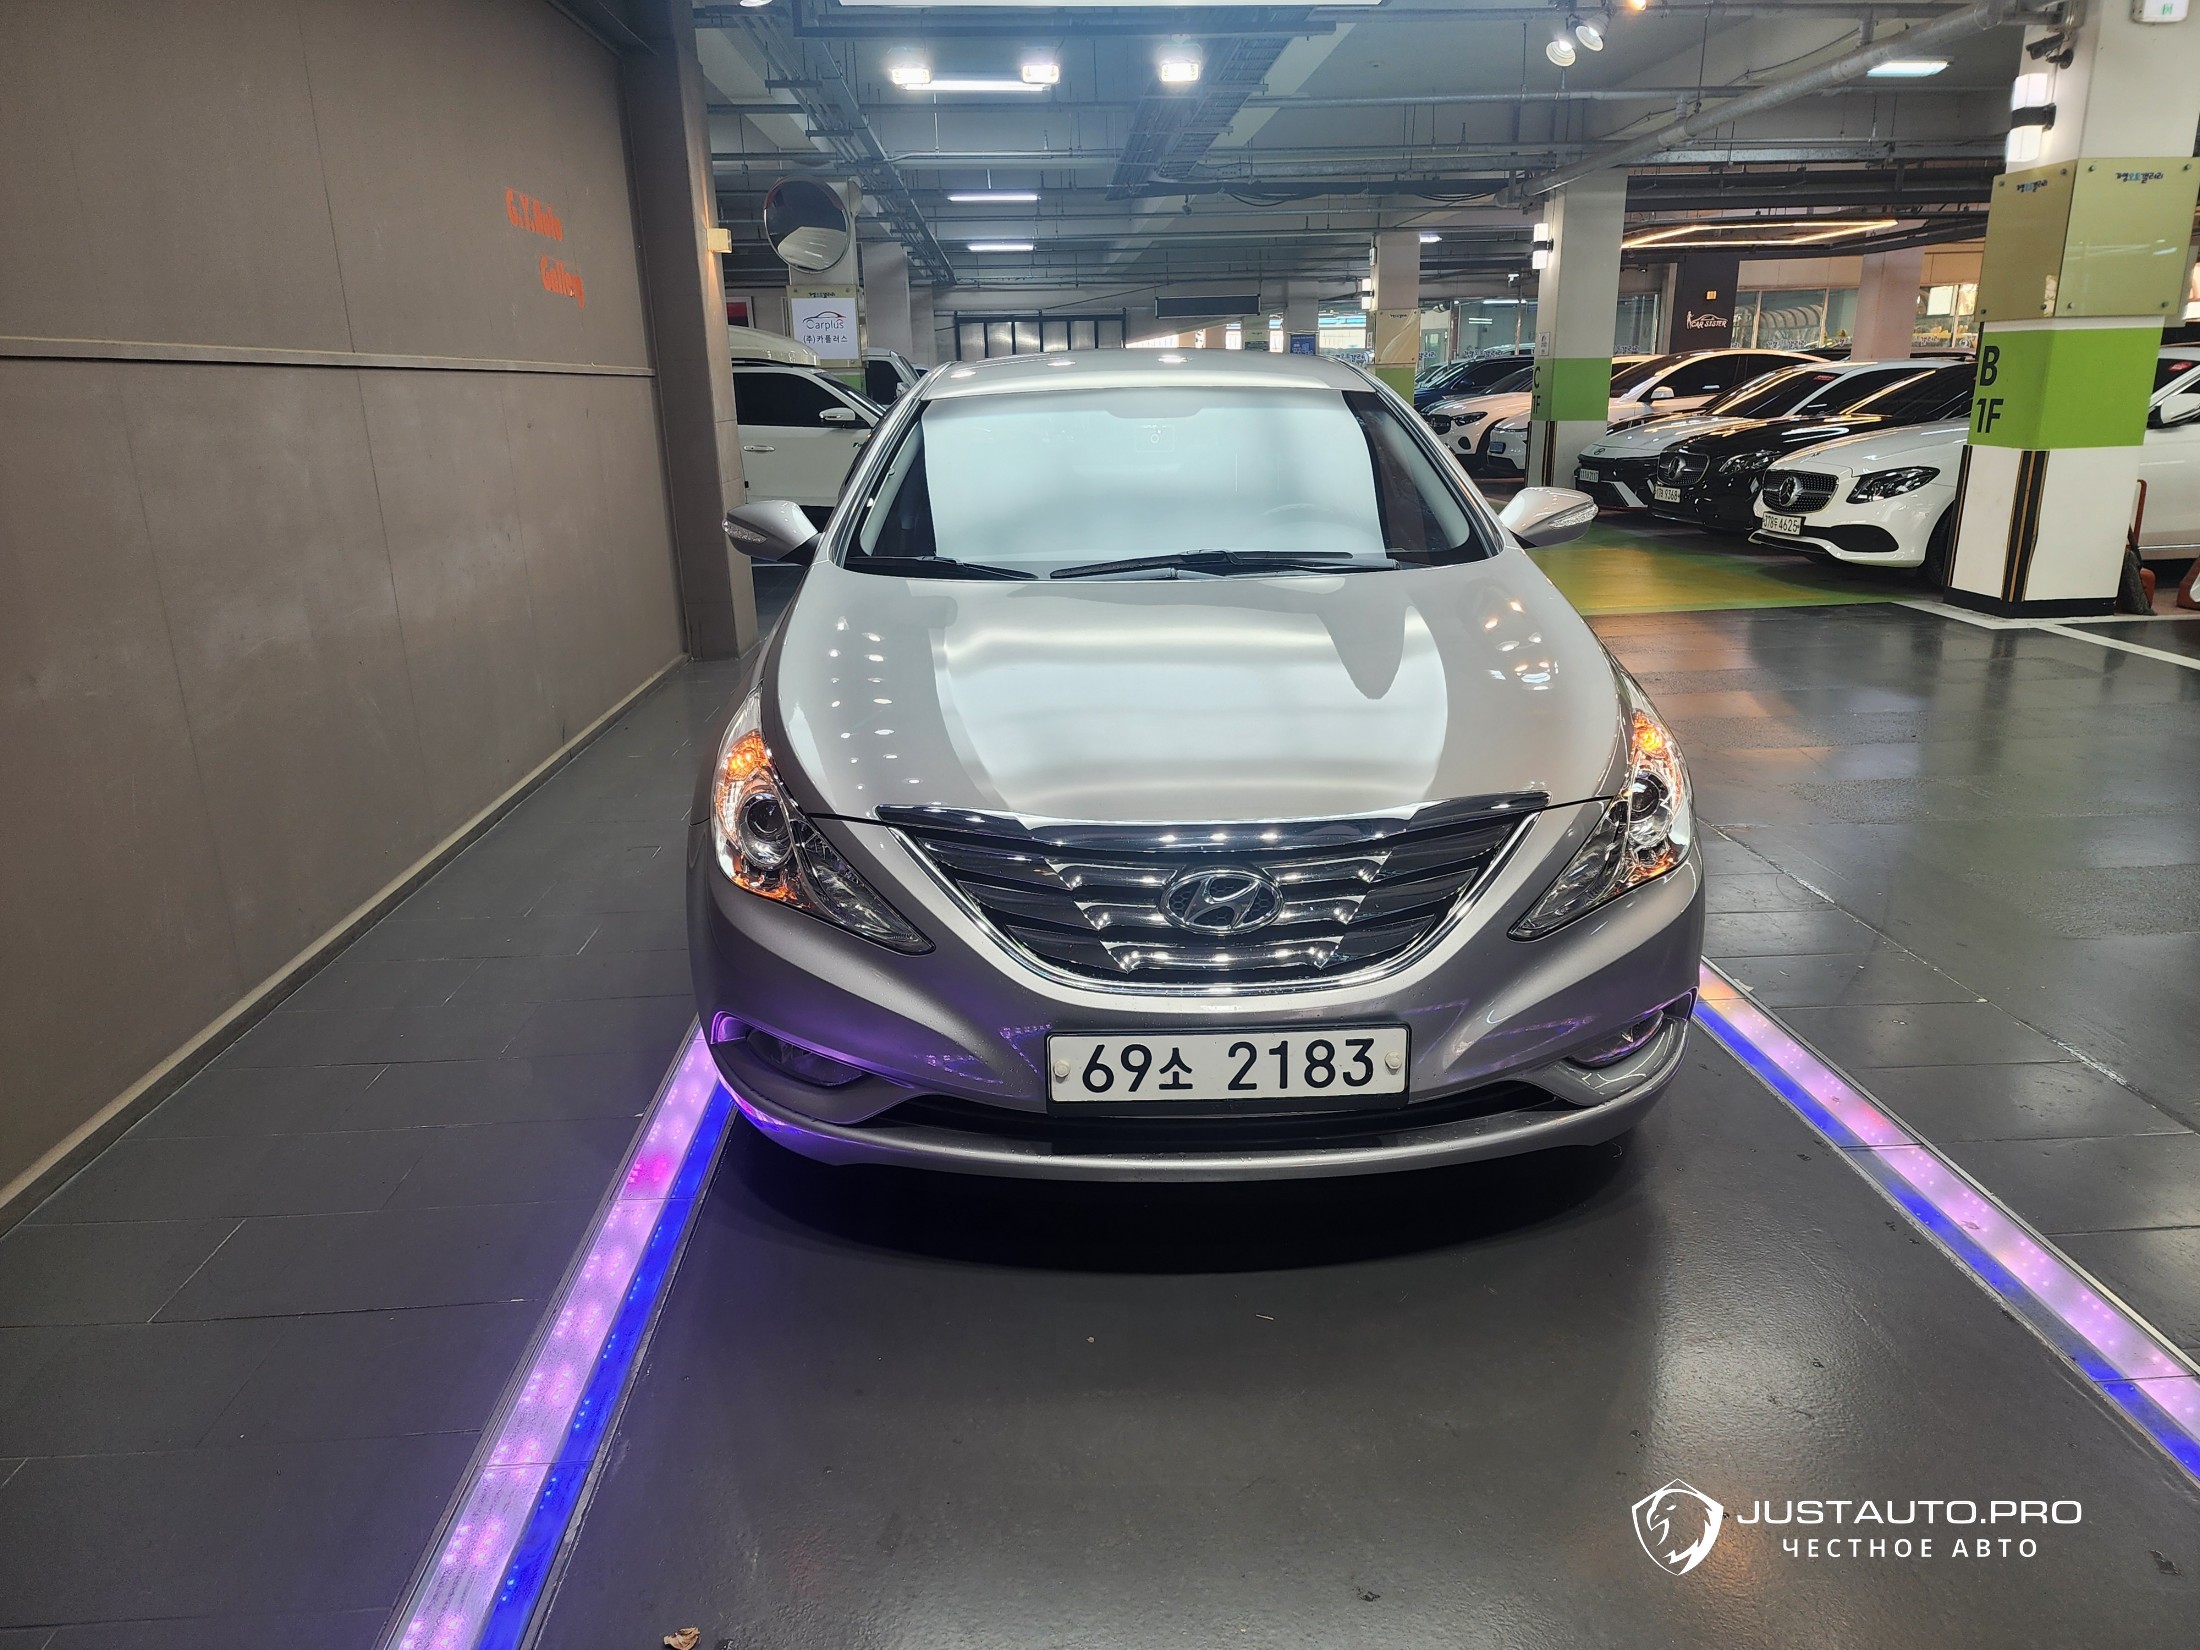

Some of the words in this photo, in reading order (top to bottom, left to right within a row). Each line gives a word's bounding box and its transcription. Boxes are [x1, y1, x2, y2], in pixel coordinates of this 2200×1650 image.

[540, 254, 585, 310] Gallery
[805, 319, 845, 332] Carplus
[1691, 320, 1704, 329] CAR
[1704, 320, 1727, 328] SISTER
[1533, 365, 1541, 390] C
[1979, 345, 2001, 387] B
[1976, 398, 2004, 434] 1F
[1779, 518, 1798, 533] 4625
[1081, 1043, 1194, 1093] 69소
[1227, 1038, 1375, 1091] 2183
